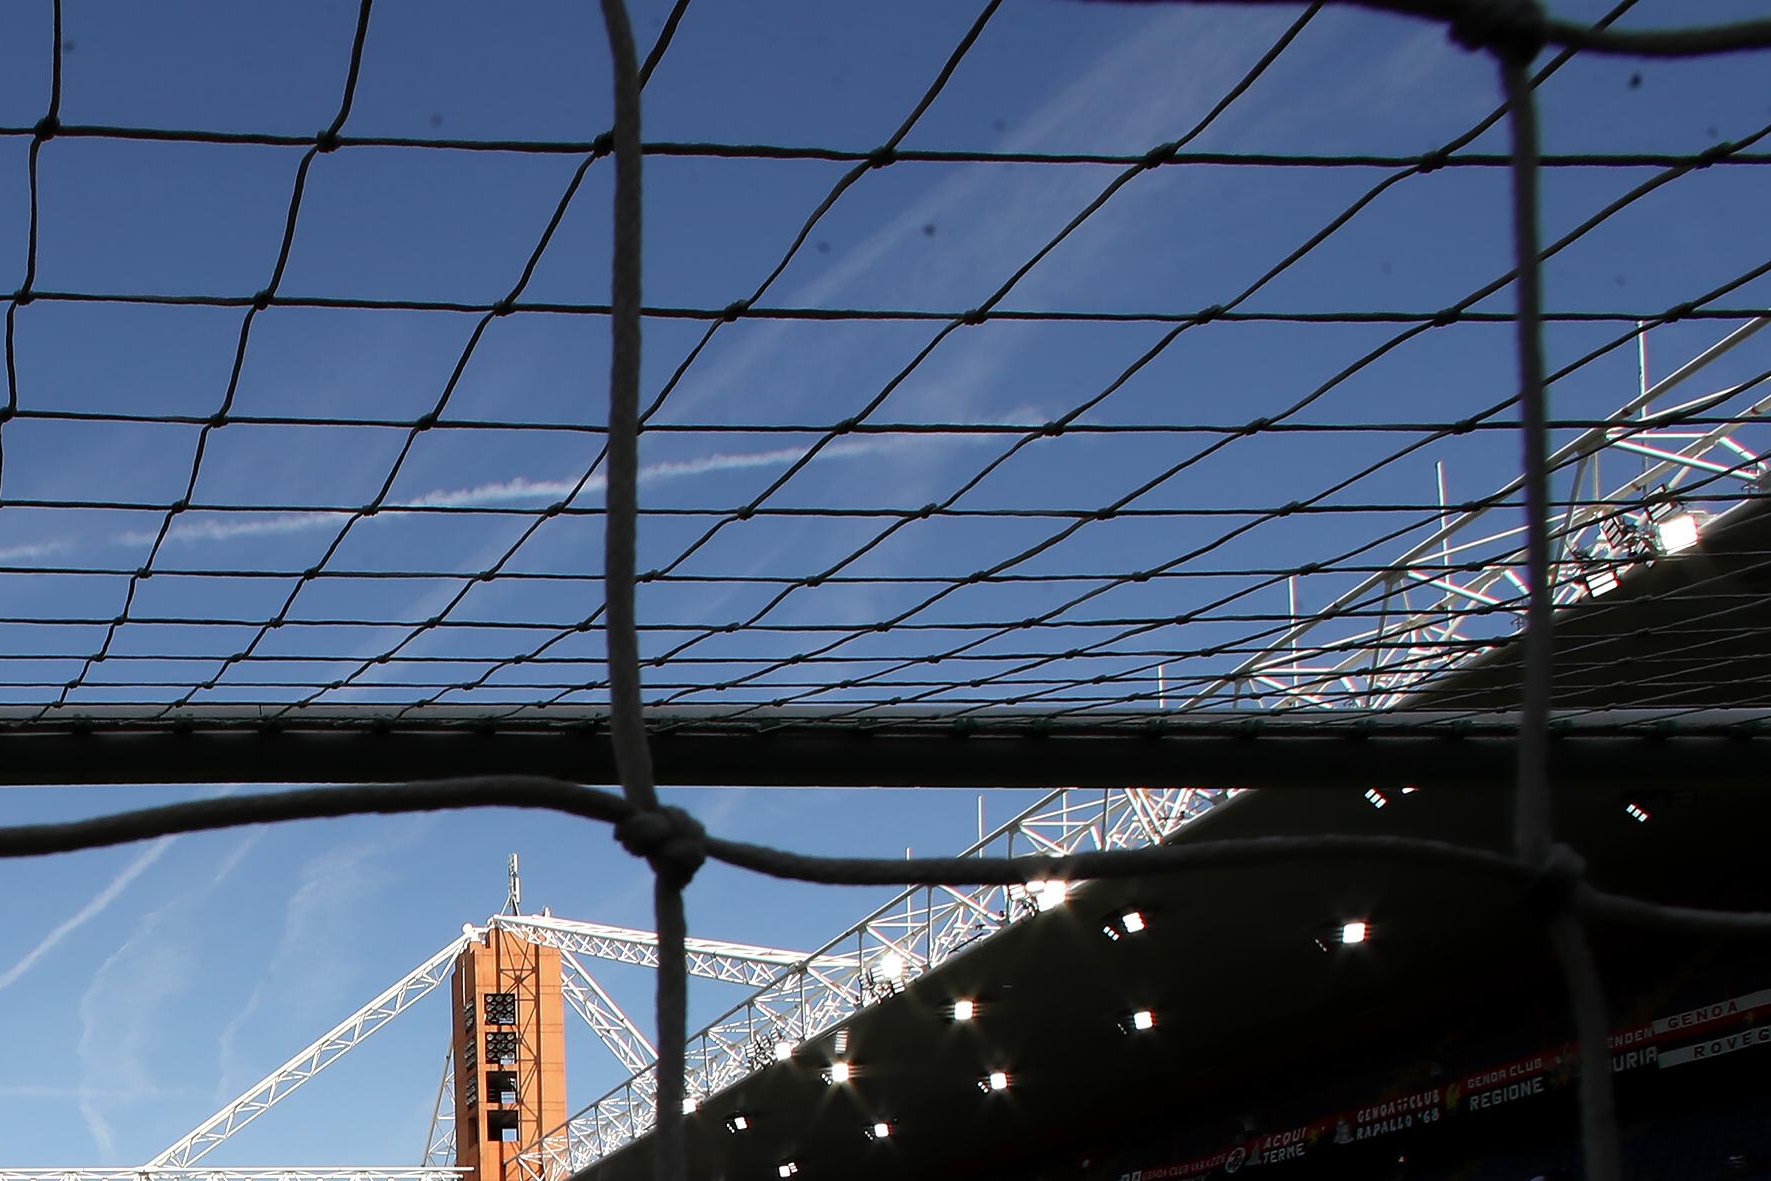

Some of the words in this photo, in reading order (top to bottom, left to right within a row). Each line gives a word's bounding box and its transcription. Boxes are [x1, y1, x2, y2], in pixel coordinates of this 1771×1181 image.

[1667, 1001, 1738, 1028] GENOA
[1467, 1070, 1507, 1089] GENOA
[1509, 1058, 1543, 1076] CLUB
[1357, 1101, 1396, 1123] GENOA
[1409, 1089, 1440, 1109] CLUB
[1469, 1076, 1545, 1112] REGIONE
[1263, 1127, 1307, 1149] ACQUI
[1356, 1114, 1414, 1141] RAPALLO
[1262, 1142, 1306, 1165] TERME
